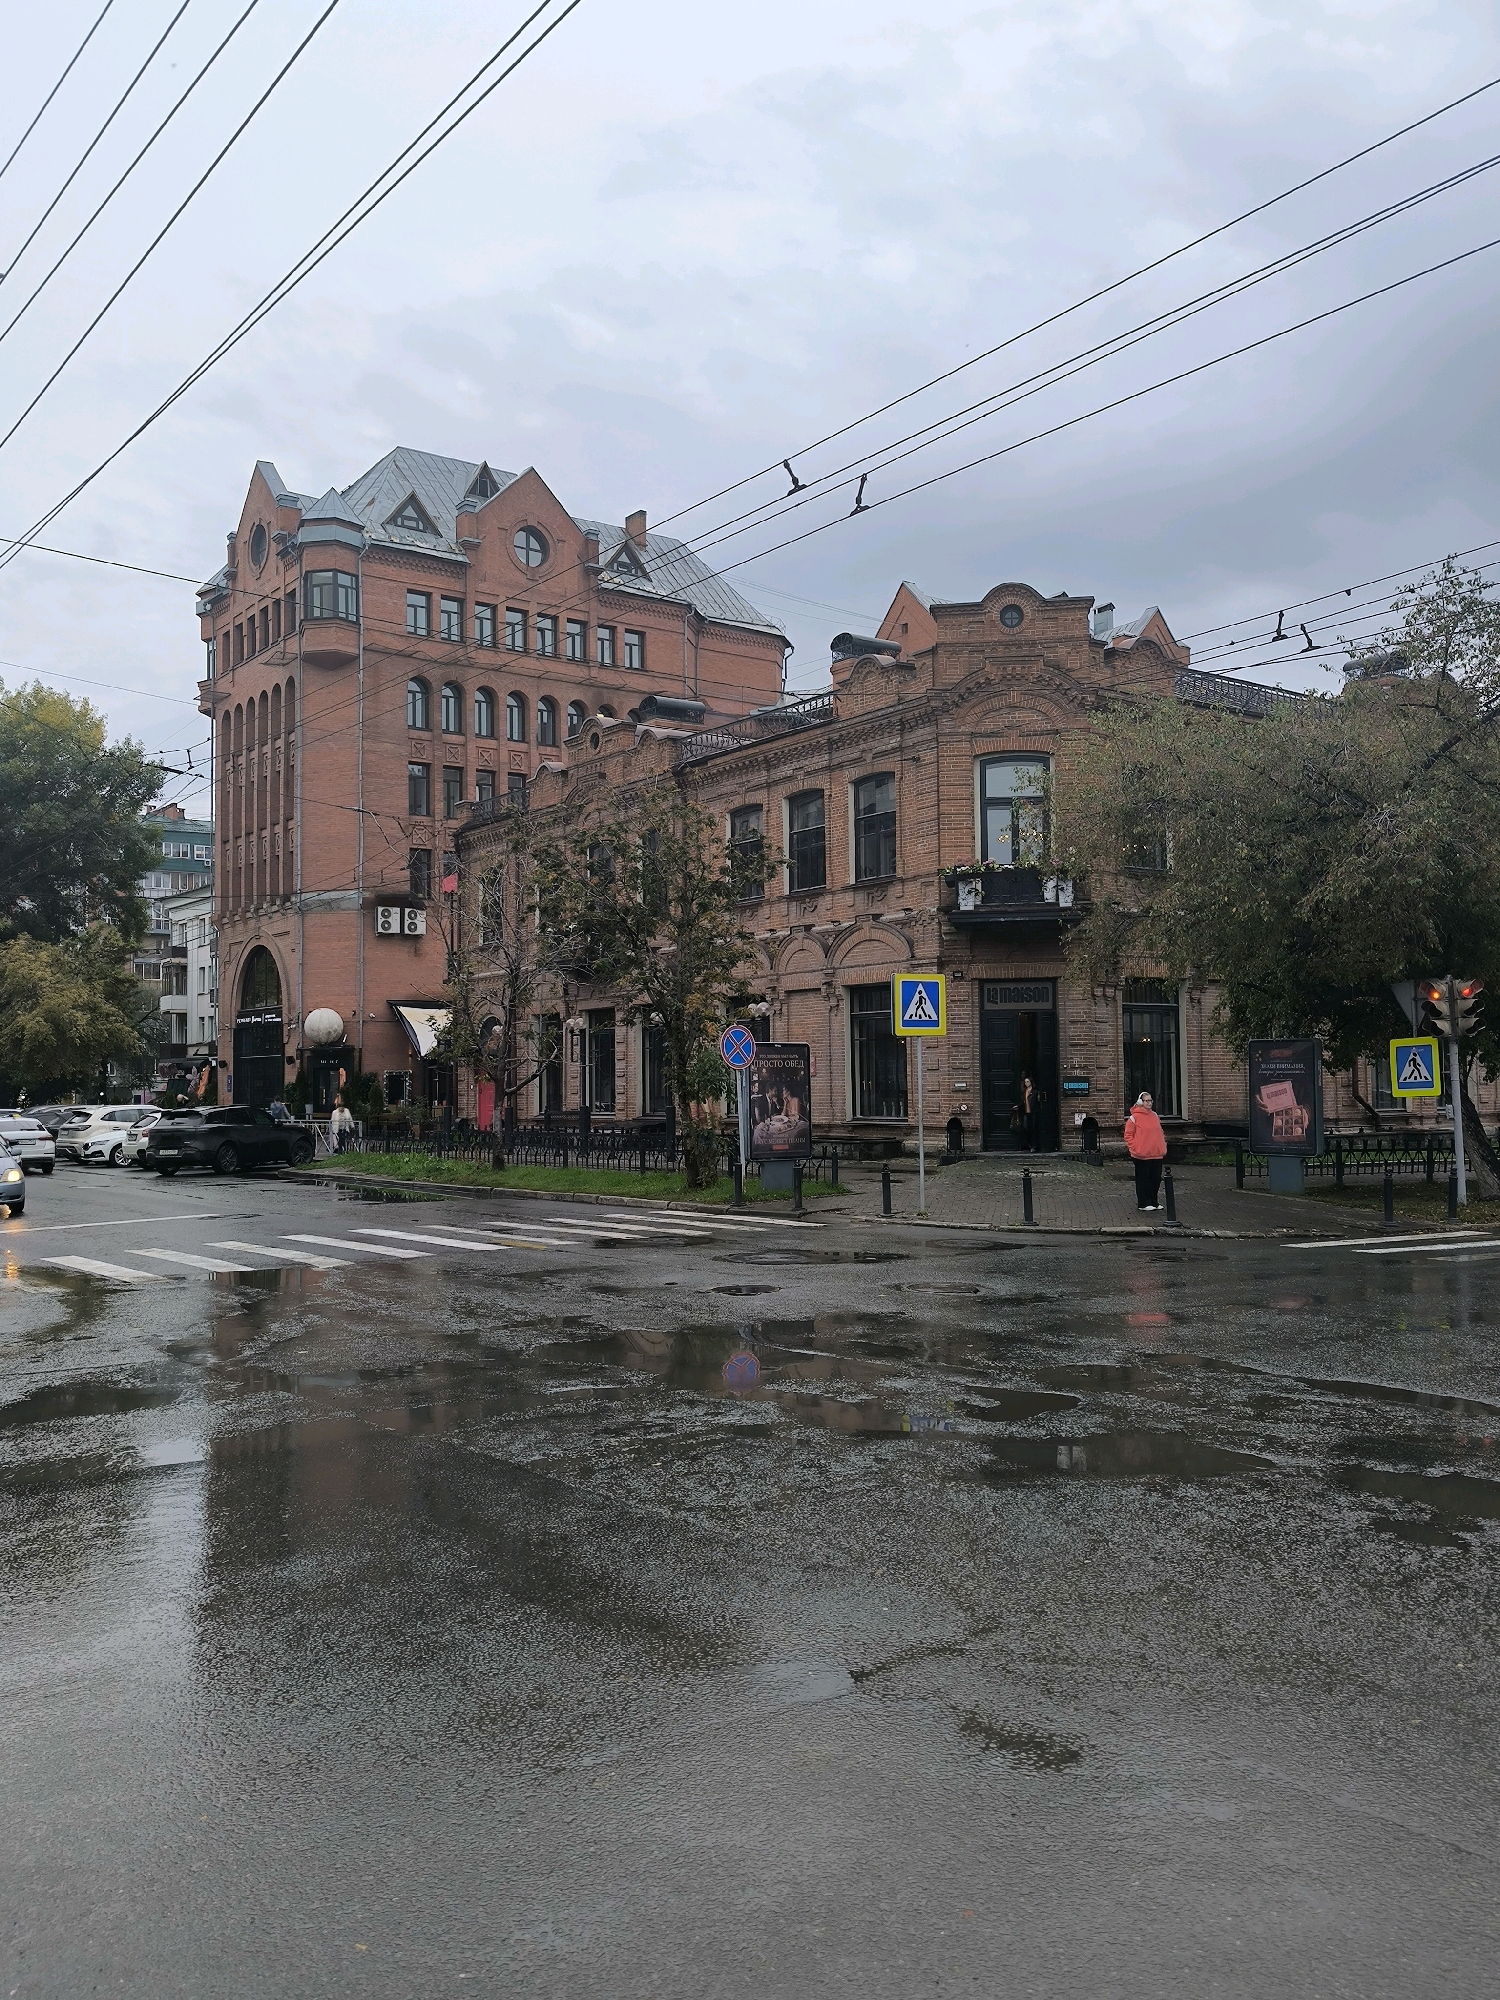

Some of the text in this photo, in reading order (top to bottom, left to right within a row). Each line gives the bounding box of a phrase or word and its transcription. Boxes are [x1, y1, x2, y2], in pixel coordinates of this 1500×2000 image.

[1000, 986, 1050, 1004] maison
[753, 1059, 784, 1068] ПРОСТО
[784, 1059, 805, 1068] ОБЕД
